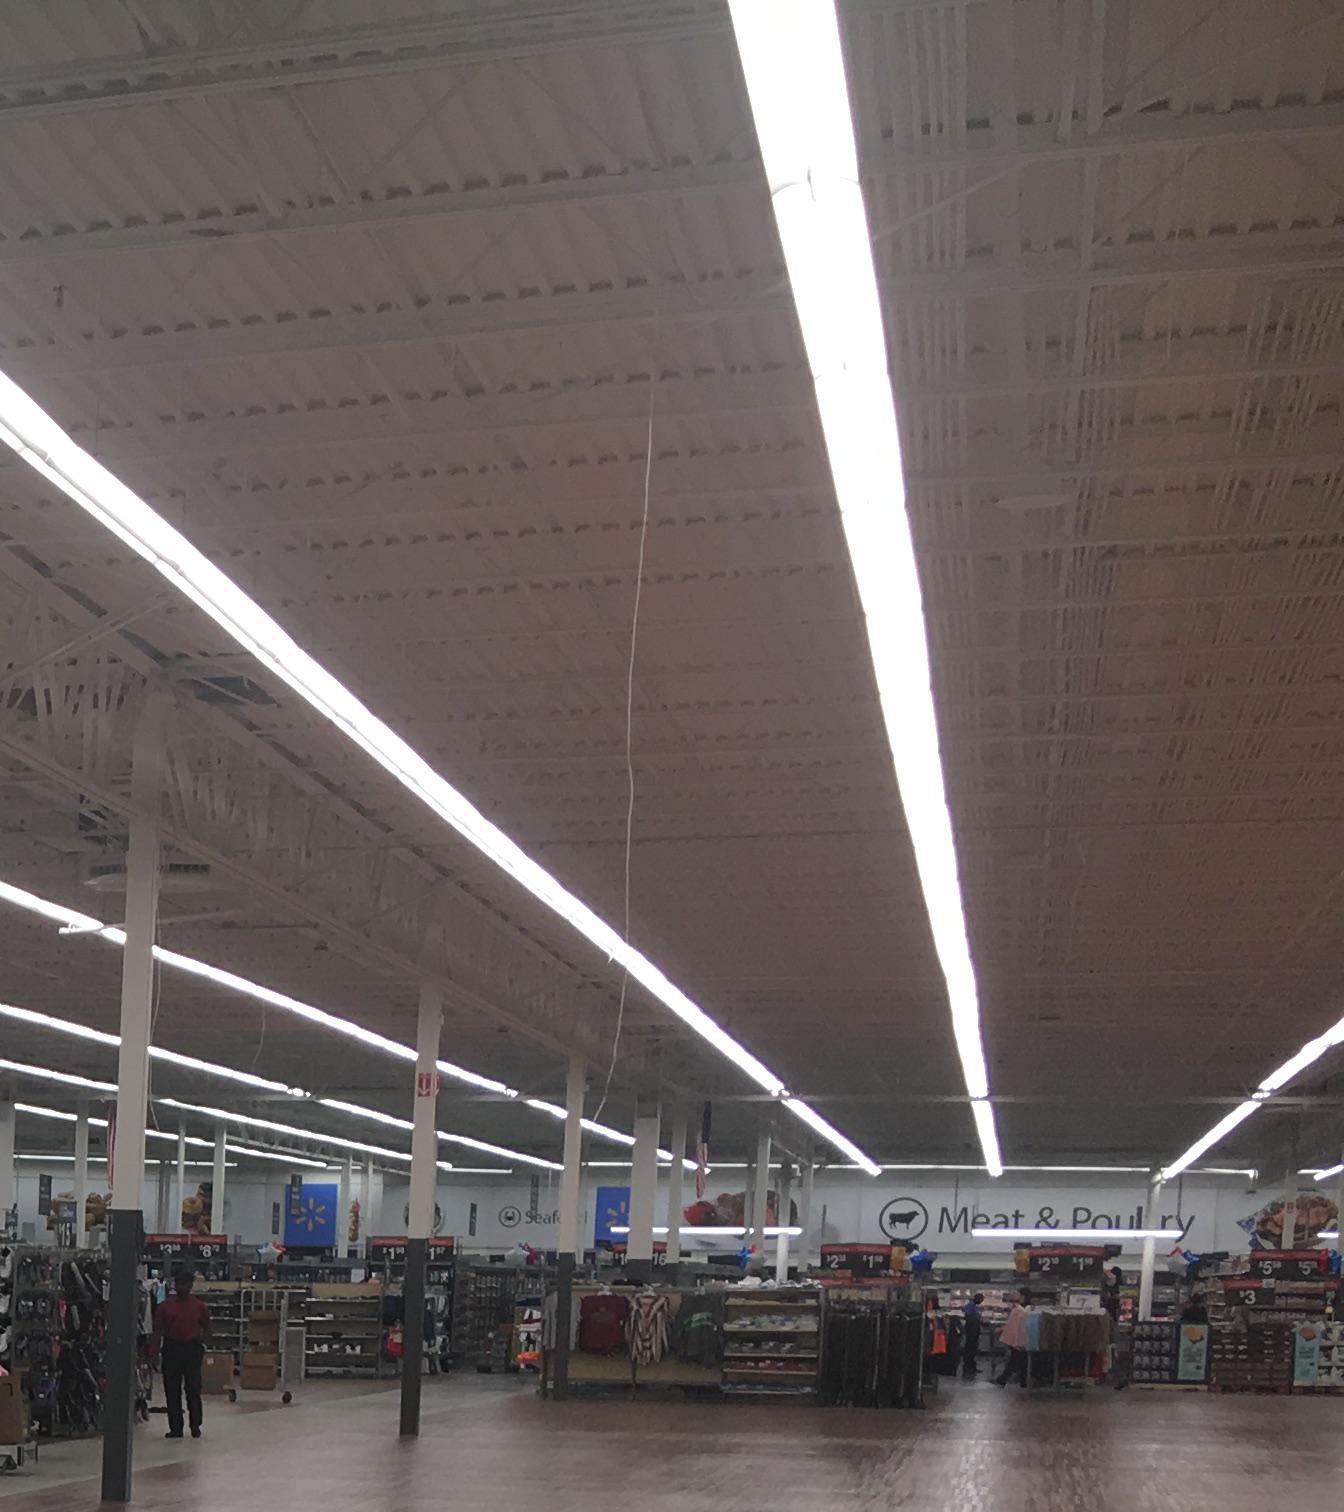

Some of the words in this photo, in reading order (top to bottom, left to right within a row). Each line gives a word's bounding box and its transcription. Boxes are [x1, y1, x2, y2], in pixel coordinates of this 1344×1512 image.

[938, 1206, 1024, 1234] Meat
[1035, 1206, 1060, 1230] &
[1072, 1206, 1196, 1243] Poulry
